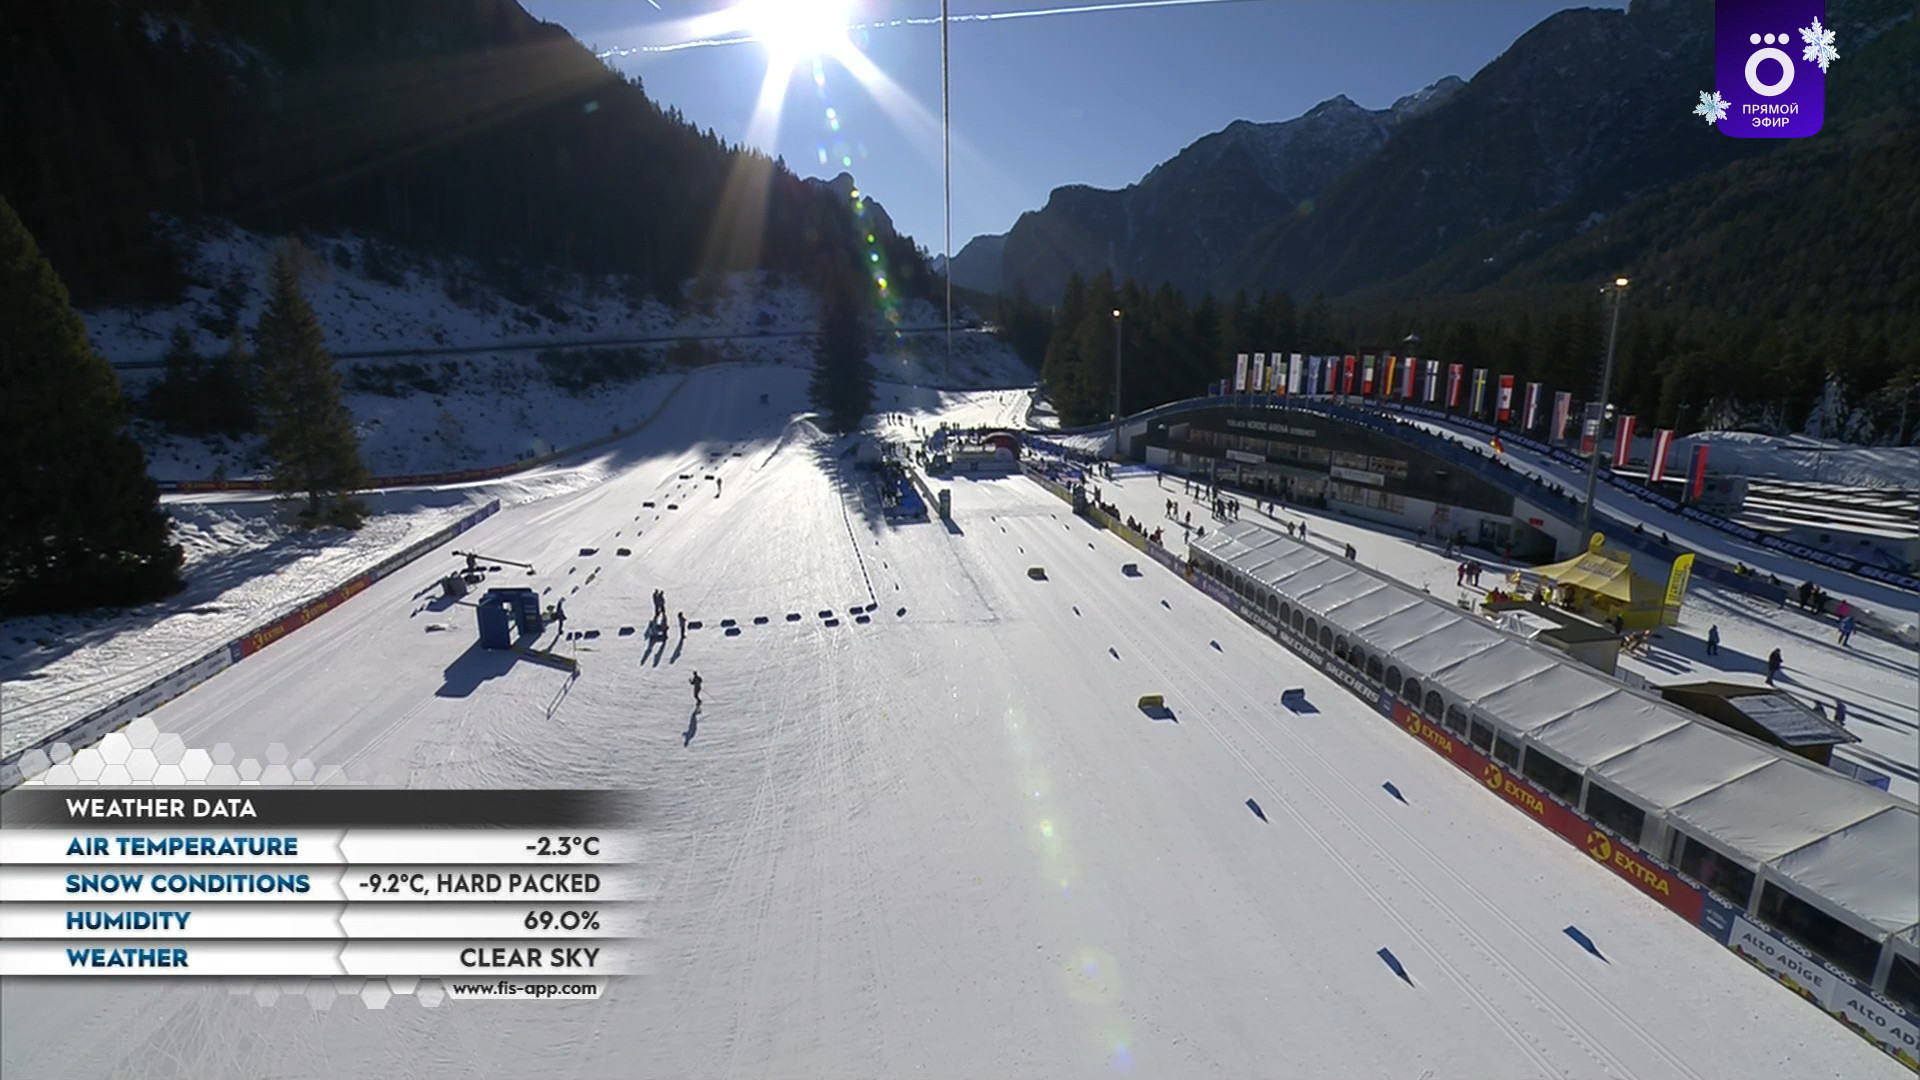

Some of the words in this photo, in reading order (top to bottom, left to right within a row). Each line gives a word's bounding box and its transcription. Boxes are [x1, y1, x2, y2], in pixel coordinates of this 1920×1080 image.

[1682, 506, 1759, 539] SKECHERS
[1762, 535, 1854, 570] SKECHERS
[1279, 631, 1324, 666] SKECHERS
[1325, 661, 1380, 703] SKECHERS
[1422, 725, 1453, 753] EXTRA
[1504, 780, 1545, 815] EXTRA
[1614, 851, 1670, 896] EXTRA
[1742, 932, 1776, 956] ALTO
[1823, 961, 1857, 986] coop
[1847, 999, 1887, 1027] ALTO
[1871, 990, 1907, 1016] coop
